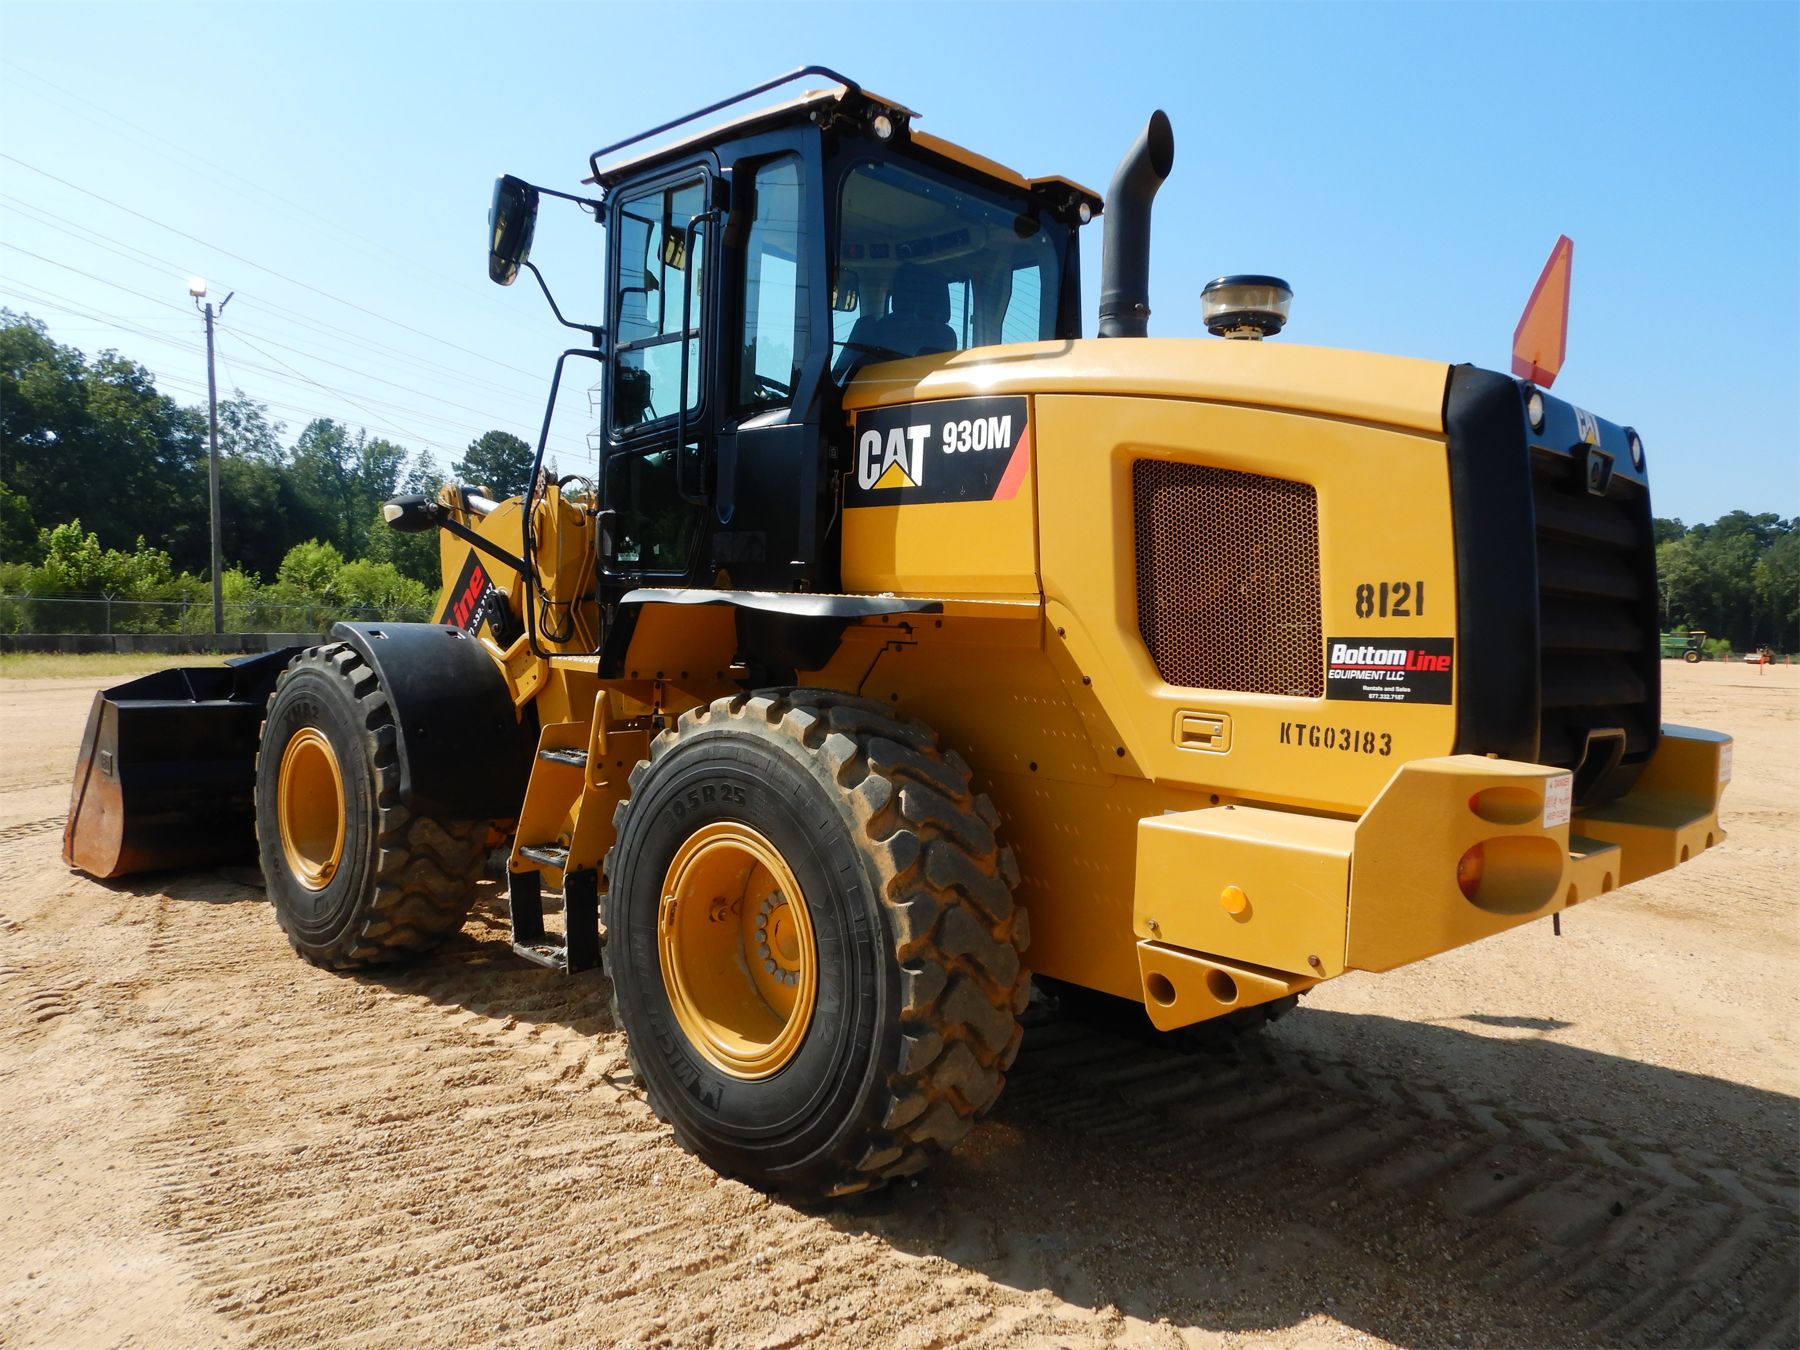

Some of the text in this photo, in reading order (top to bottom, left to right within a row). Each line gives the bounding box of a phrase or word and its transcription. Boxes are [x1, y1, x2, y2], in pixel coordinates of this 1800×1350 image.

[1573, 406, 1601, 447] CAT
[858, 415, 1012, 491] CAT 930M
[446, 565, 486, 629] ine
[1355, 581, 1424, 618] 8121
[1328, 669, 1405, 681] EQUIPMENT LLC
[1279, 722, 1393, 757] KTG03183
